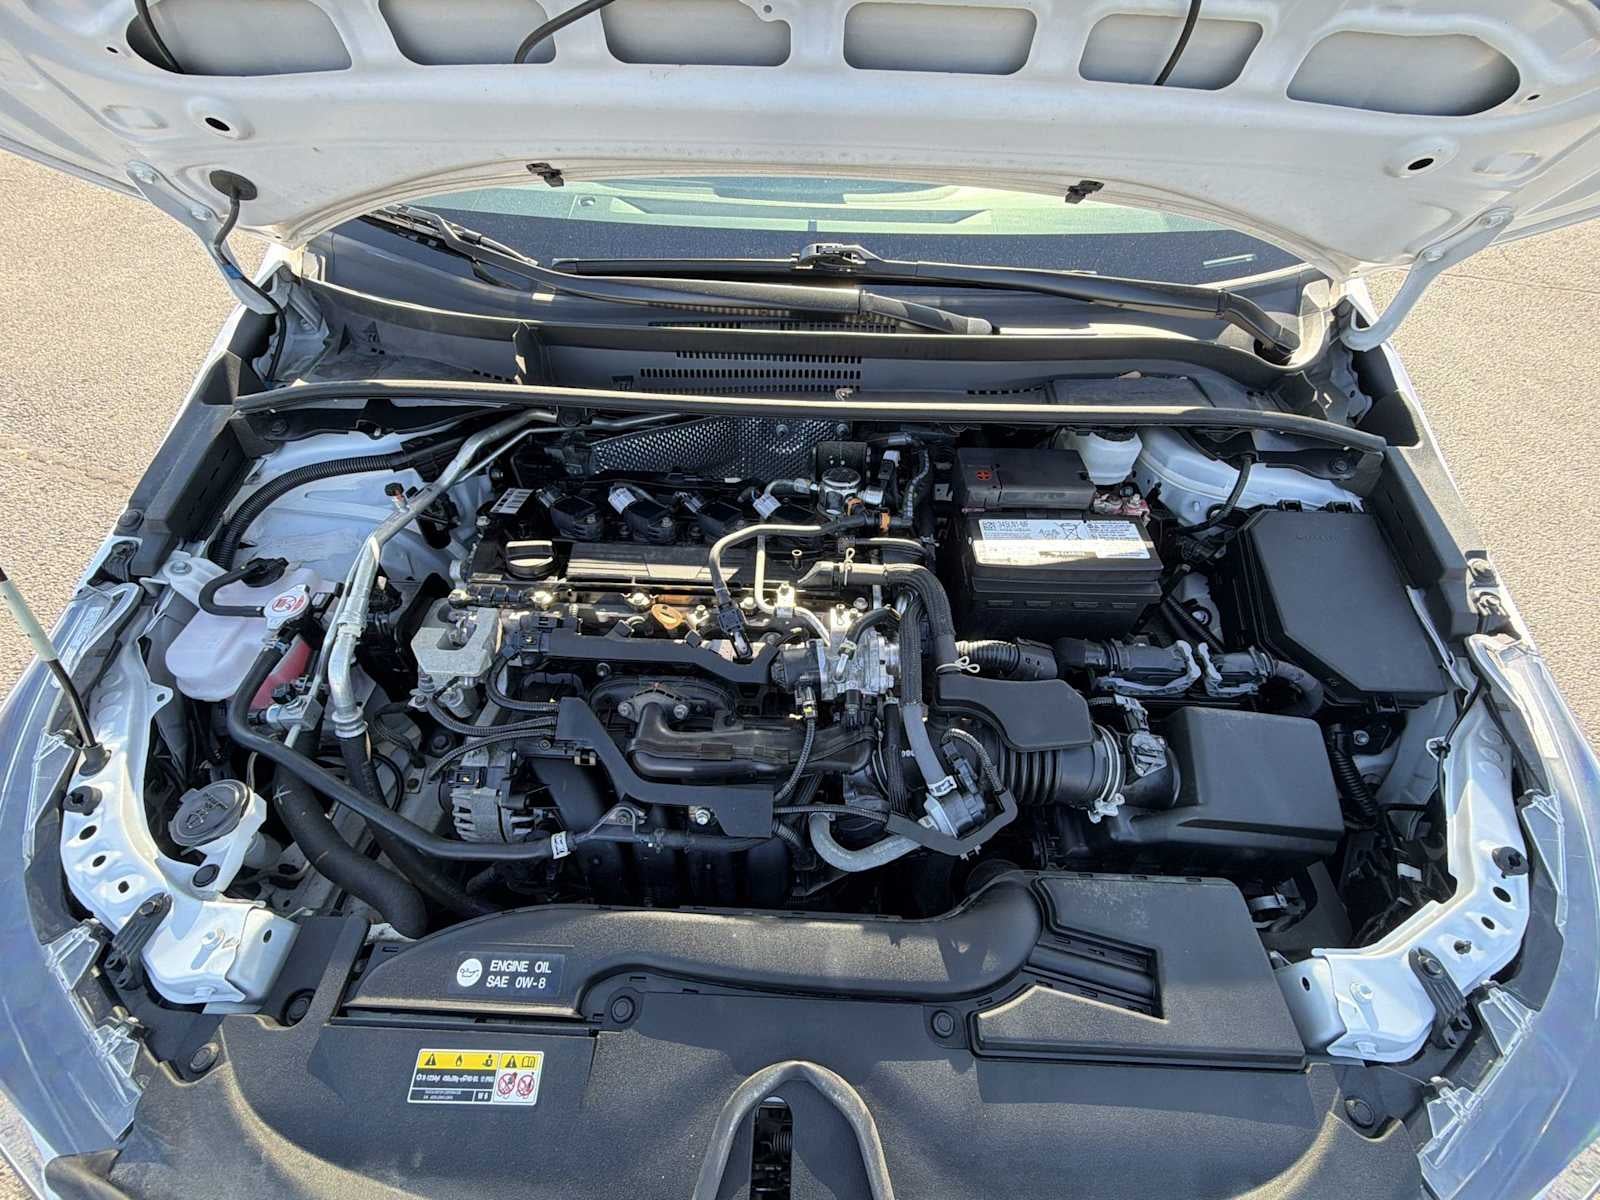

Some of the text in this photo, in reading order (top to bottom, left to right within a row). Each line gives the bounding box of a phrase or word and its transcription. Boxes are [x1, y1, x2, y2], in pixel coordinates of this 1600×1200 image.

[490, 960, 552, 974] ENGINE OIL
[486, 976, 546, 989] SAE 0W-8
